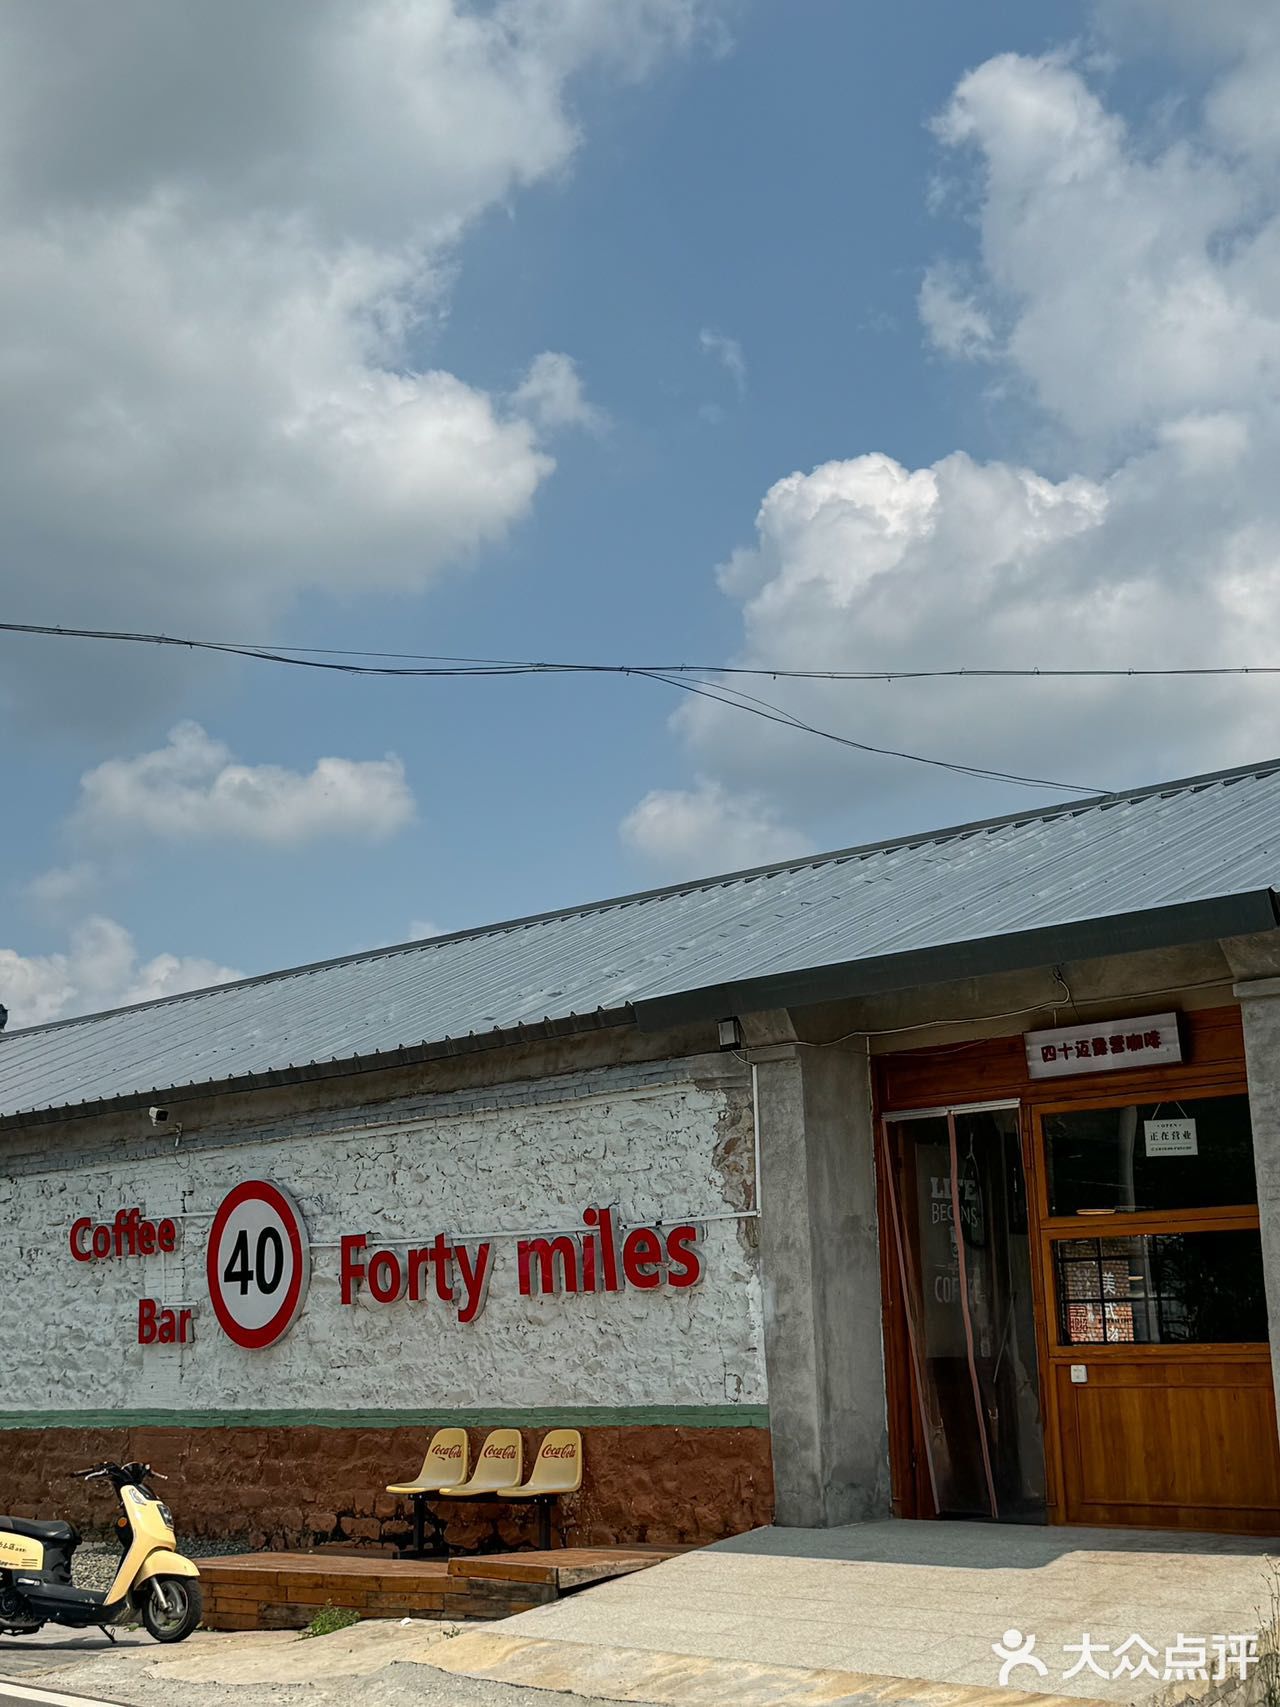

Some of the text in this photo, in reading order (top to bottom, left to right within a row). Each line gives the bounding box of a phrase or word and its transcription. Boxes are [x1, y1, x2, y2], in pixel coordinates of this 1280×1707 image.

[69, 1207, 177, 1262] Coffee
[931, 1203, 978, 1227] BEGNS
[224, 1226, 284, 1295] 40
[340, 1208, 701, 1323] Forty miles
[138, 1299, 191, 1344] Bar
